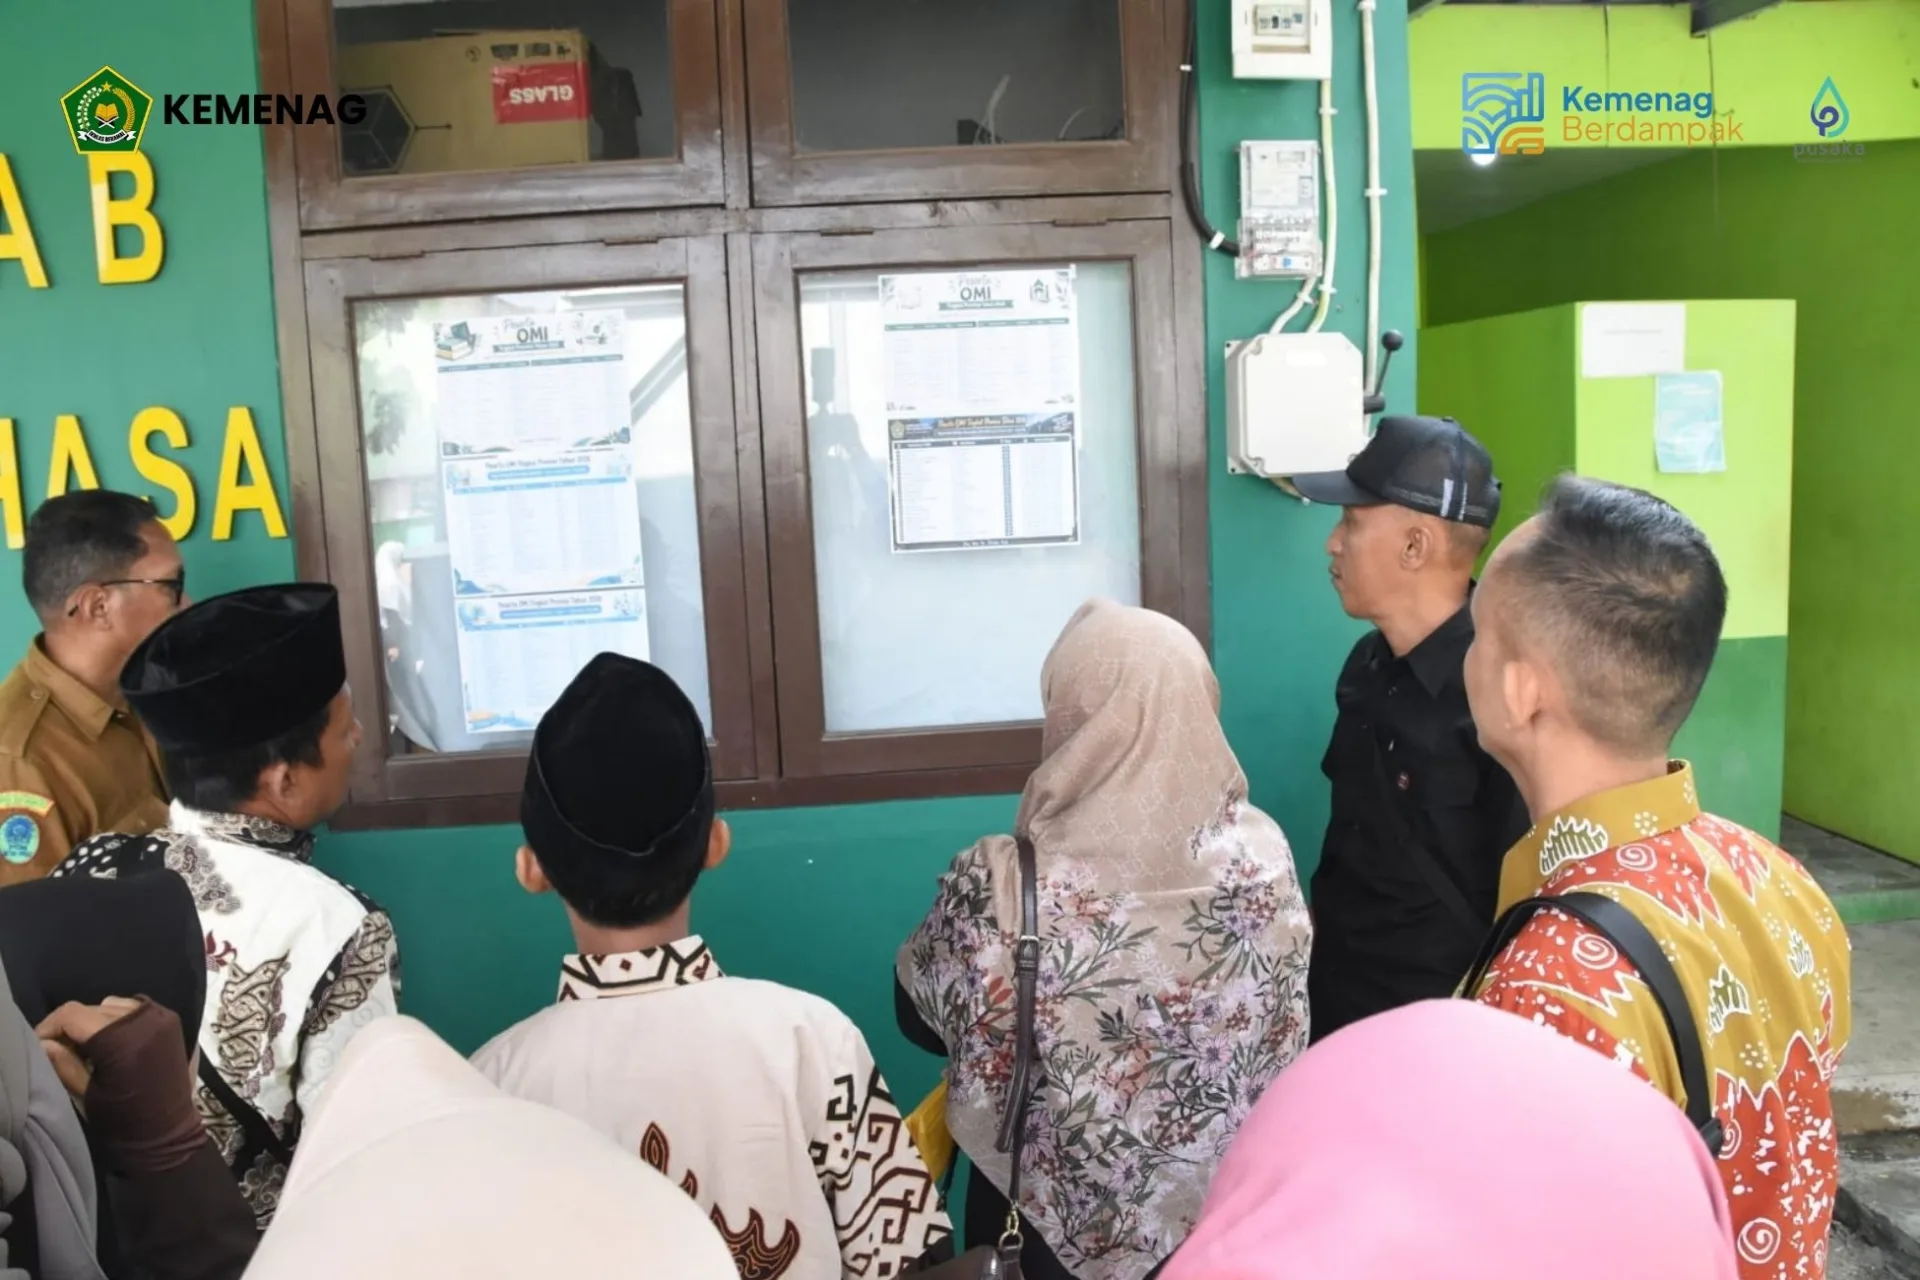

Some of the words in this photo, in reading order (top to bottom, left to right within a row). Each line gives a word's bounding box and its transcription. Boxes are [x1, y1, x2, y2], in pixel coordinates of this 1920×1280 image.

[509, 84, 574, 105] GLASS
[960, 286, 991, 301] OMI
[516, 325, 549, 343] OMI
